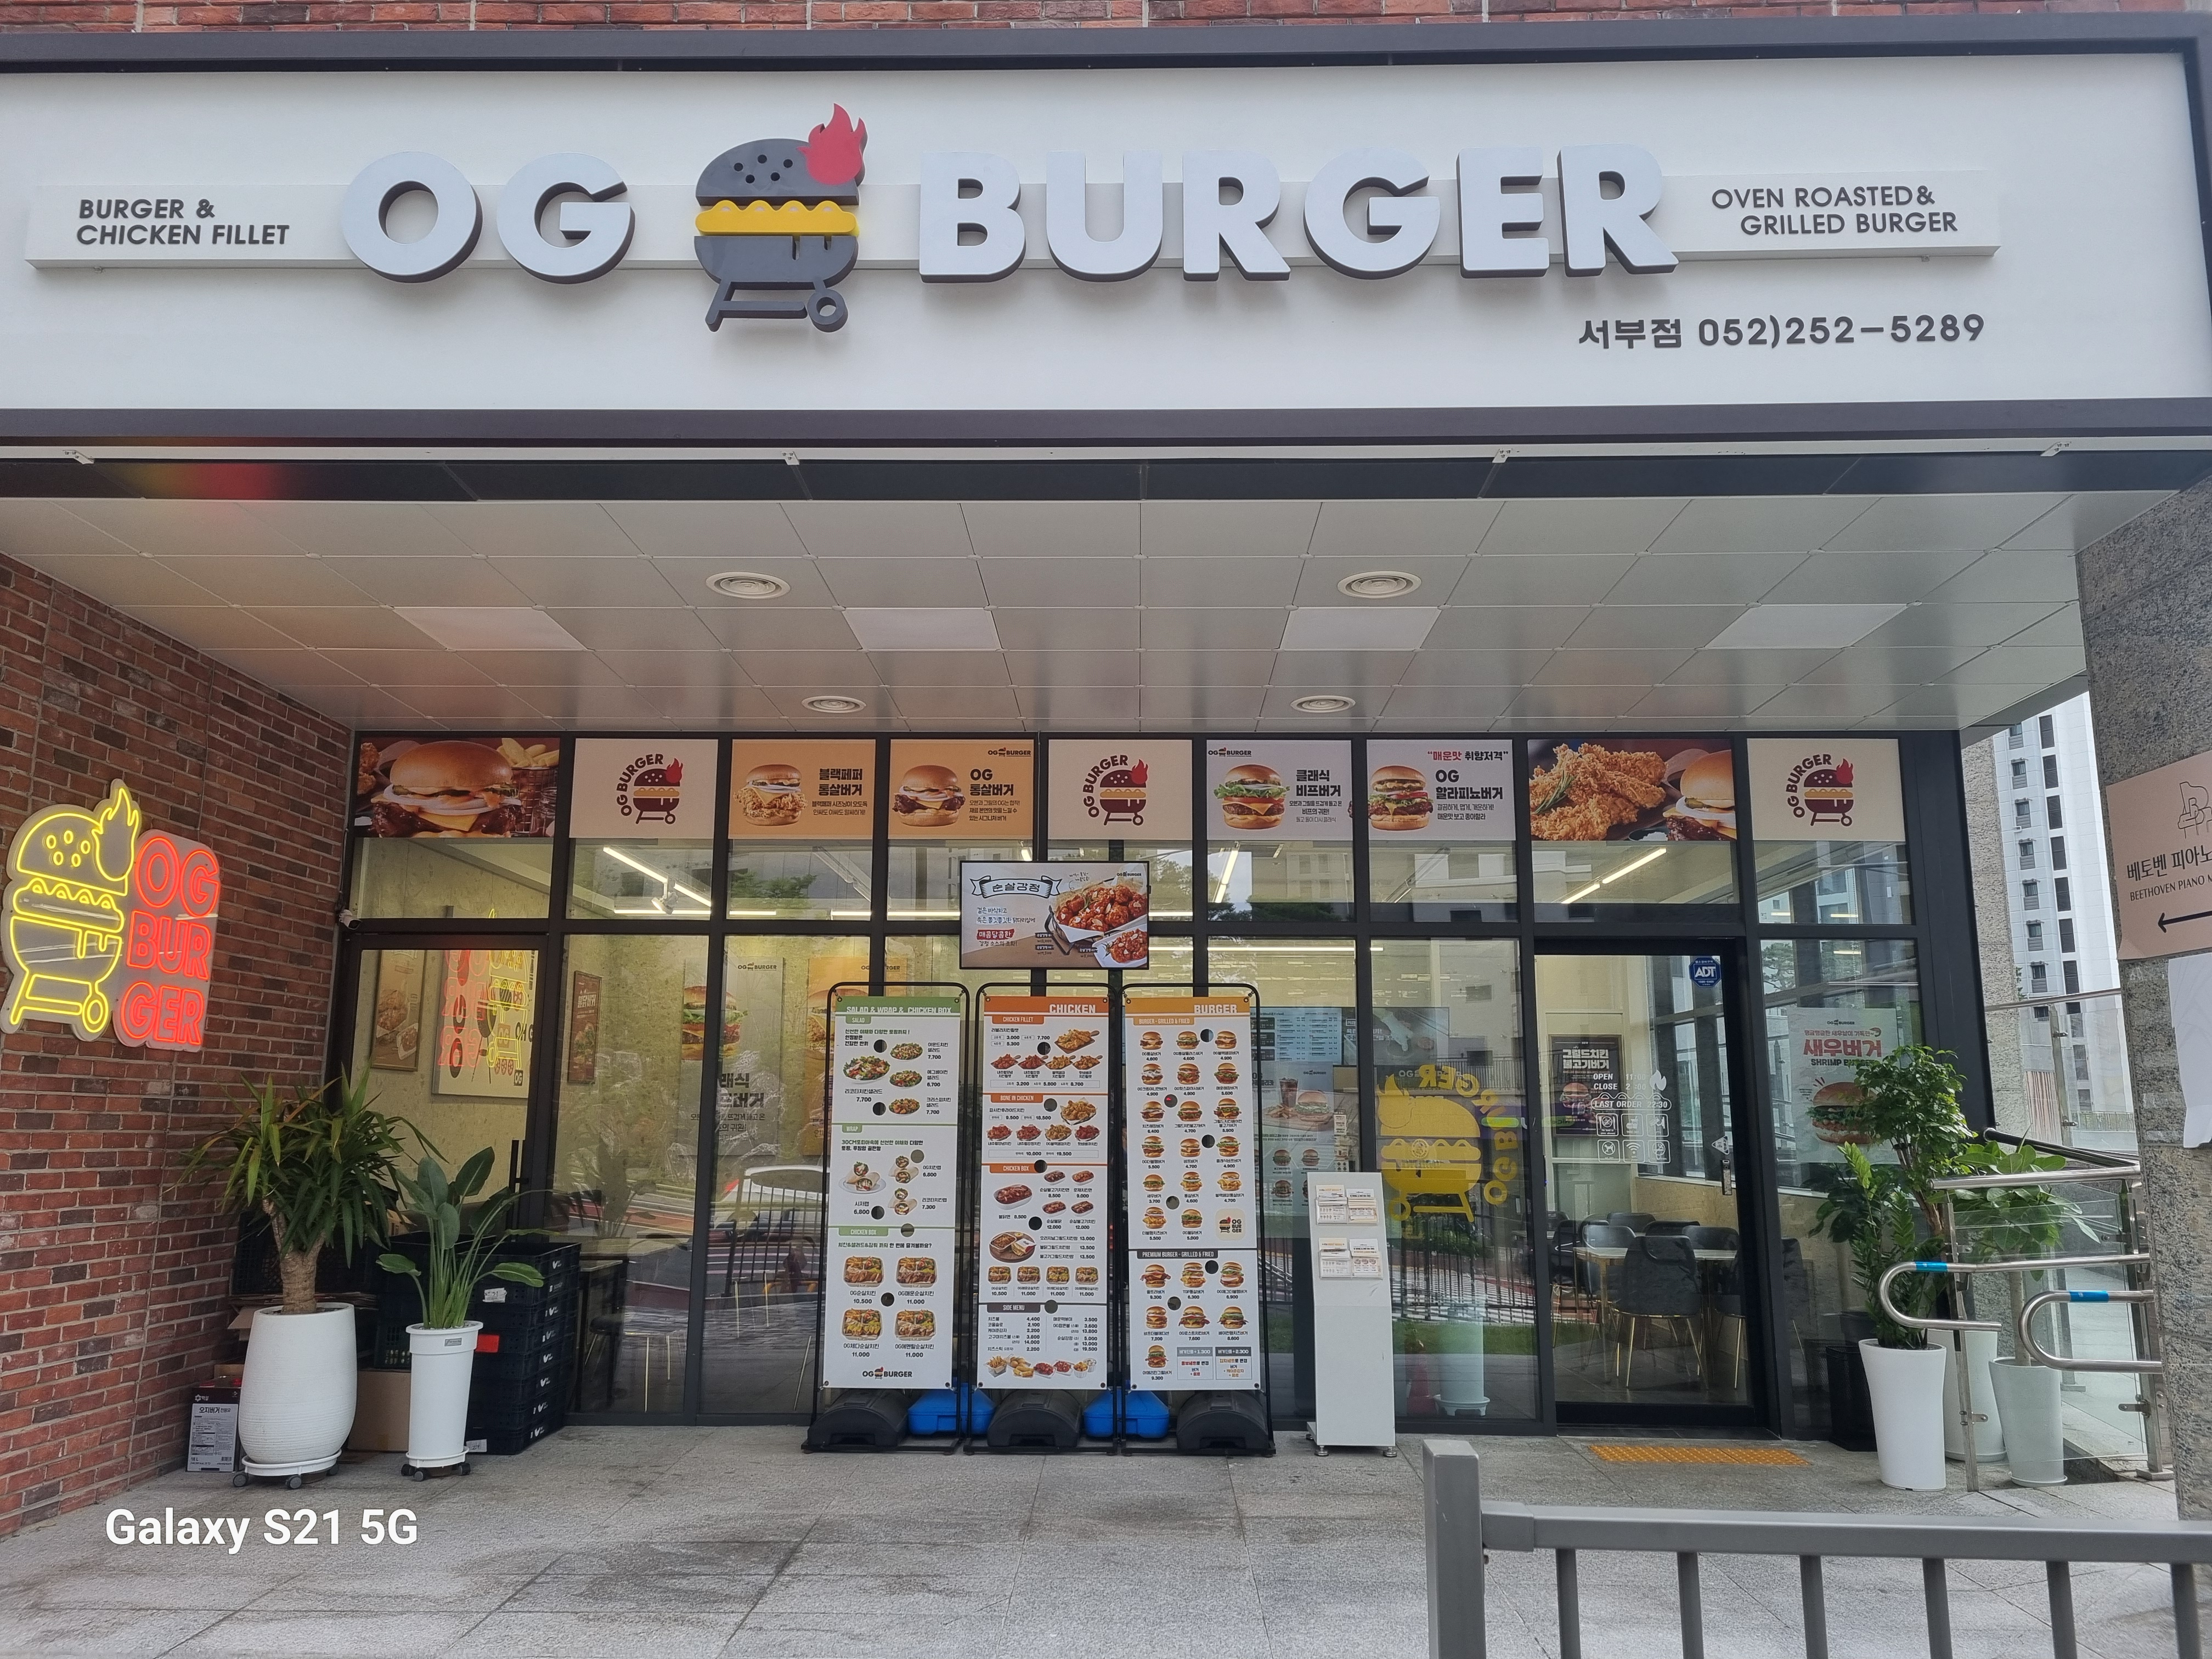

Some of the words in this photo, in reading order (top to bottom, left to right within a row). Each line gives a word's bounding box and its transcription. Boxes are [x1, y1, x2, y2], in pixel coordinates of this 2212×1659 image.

[1712, 188, 1784, 209] OVEN
[79, 198, 184, 219] BURGER
[195, 198, 215, 219] &
[342, 151, 635, 284] OG
[919, 143, 1678, 283] BURGER
[1741, 215, 1845, 235] GRILLED
[1856, 212, 1957, 234] BURGER
[76, 224, 201, 246] CHICKEN
[211, 224, 290, 245] FILLET
[1579, 319, 1681, 349] 서부점
[1699, 314, 1985, 348] 052)252-5289
[616, 754, 664, 792] BURGER
[820, 769, 862, 780] 블랙페퍼
[970, 769, 992, 781] OG
[1082, 754, 1128, 793] BURGER
[1296, 770, 1329, 781] 클래식
[1436, 770, 1459, 782] OG
[1786, 754, 1832, 793] BURGER
[819, 784, 862, 795] 통살버거
[970, 784, 1014, 795] 통살버거
[1296, 785, 1340, 797] 비프버거
[1436, 787, 1503, 799] 할라피뇨버거
[2127, 854, 2167, 881] 베토벤
[134, 837, 219, 918] OG
[992, 883, 1040, 892] 순살강정
[2130, 882, 2176, 901] BEETHOVEN
[2179, 875, 2205, 890] PIANO
[127, 910, 211, 979] BUR
[1695, 967, 1716, 977] ADT
[121, 981, 204, 1045] GER
[1049, 1004, 1096, 1013] CHICKEN
[1194, 1005, 1237, 1013] BURGER
[1563, 1049, 1609, 1058] 그릴드치킨
[1803, 1039, 1882, 1057] 새우버거
[1563, 1059, 1609, 1069] 불고기버거
[515, 1072, 522, 1084] OG
